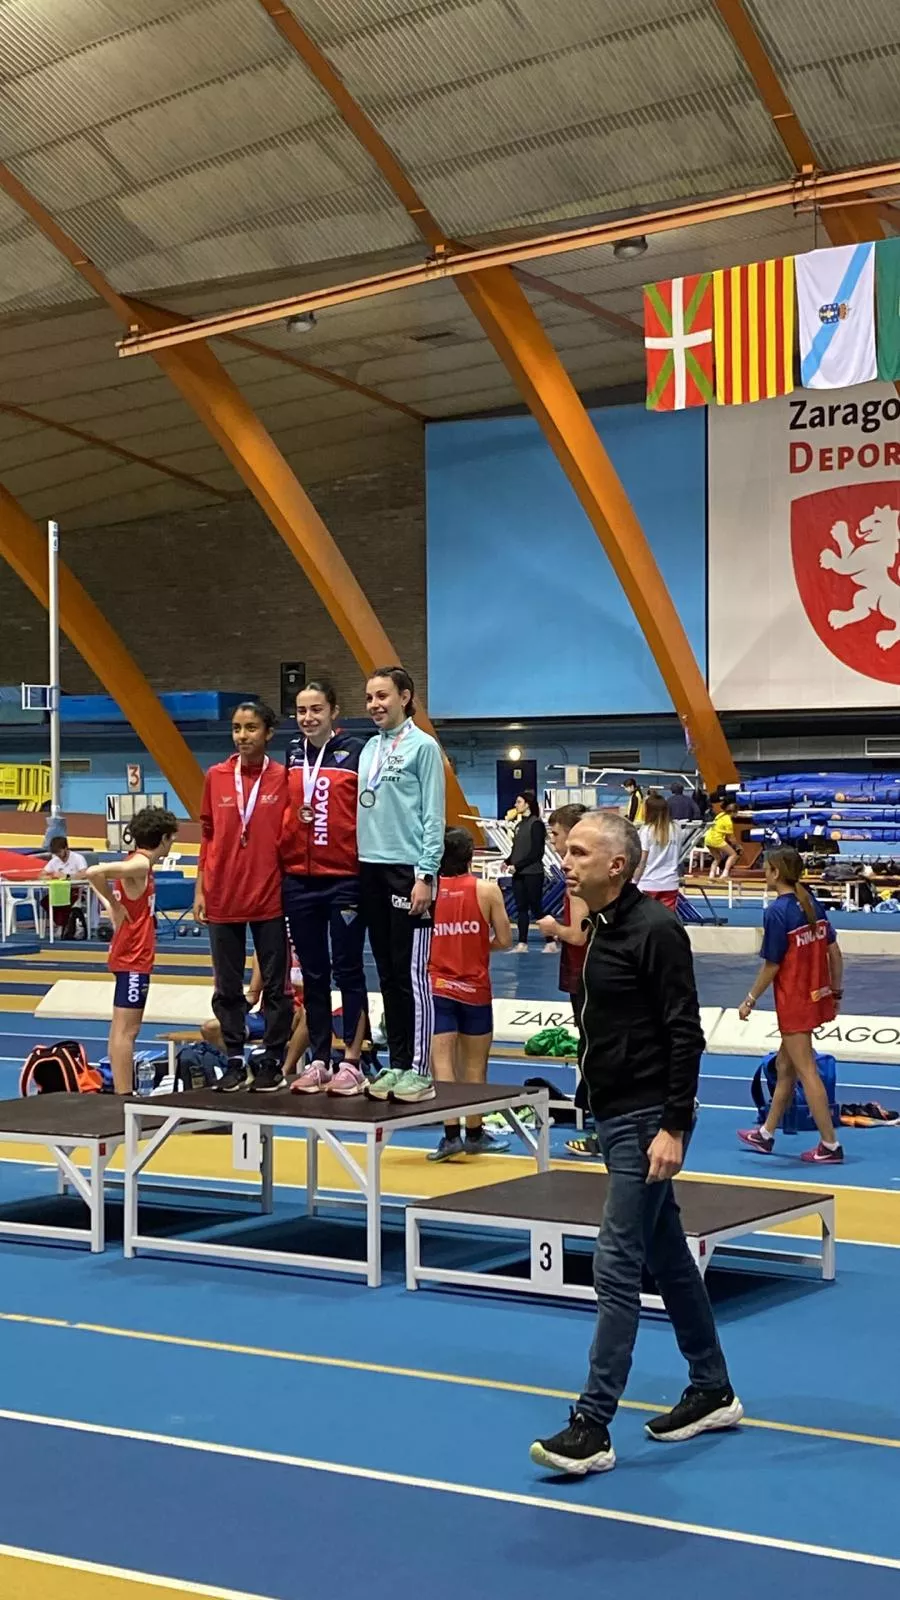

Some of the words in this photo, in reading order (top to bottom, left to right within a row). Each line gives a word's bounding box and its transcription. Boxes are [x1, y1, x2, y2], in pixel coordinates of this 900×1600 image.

[789, 398, 900, 433] Zarago
[128, 766, 140, 786] 3
[107, 796, 116, 820] N
[313, 776, 331, 846] HINACO
[544, 790, 552, 809] N
[242, 1132, 248, 1159] 1
[540, 1241, 552, 1271] 3
